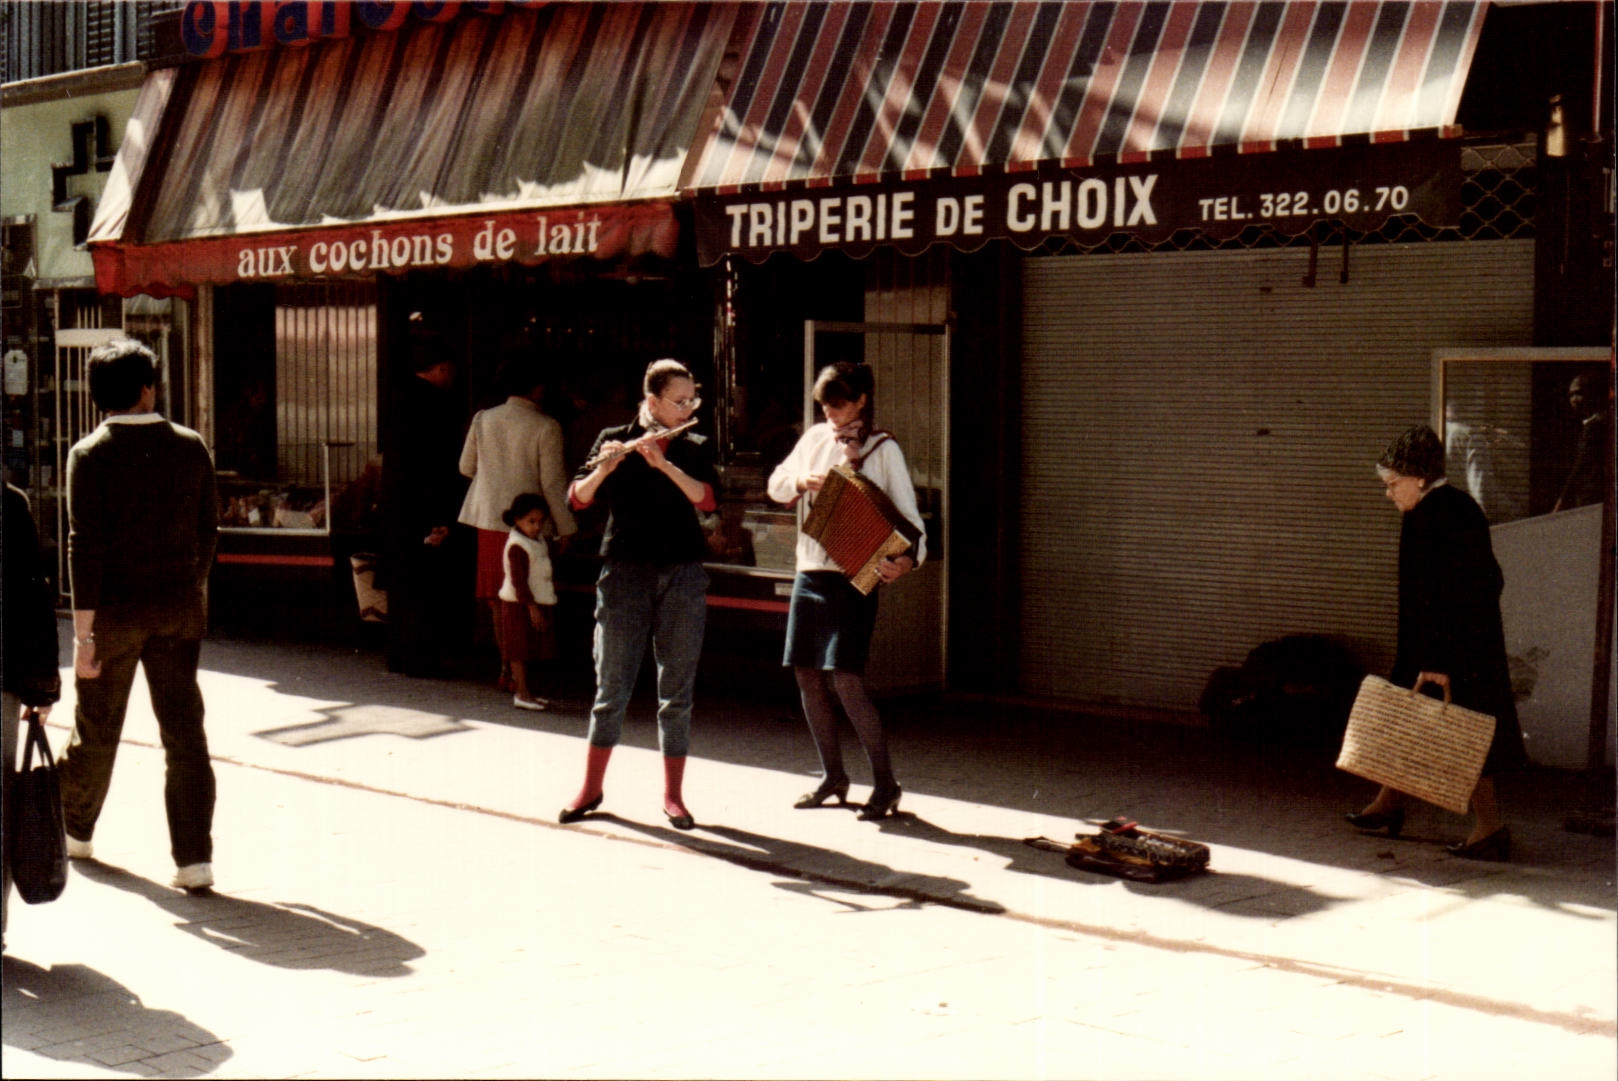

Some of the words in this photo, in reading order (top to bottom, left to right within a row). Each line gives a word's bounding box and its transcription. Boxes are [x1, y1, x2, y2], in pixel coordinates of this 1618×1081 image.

[725, 192, 915, 248] TRIPERIE
[936, 195, 984, 236] DE
[1006, 174, 1159, 232] CHOIX
[1199, 197, 1253, 221] TEL.
[1260, 186, 1409, 217] 322.06.70
[237, 245, 298, 278] aux
[309, 230, 453, 273] cochons
[473, 220, 516, 260] de
[534, 211, 601, 255] lait
